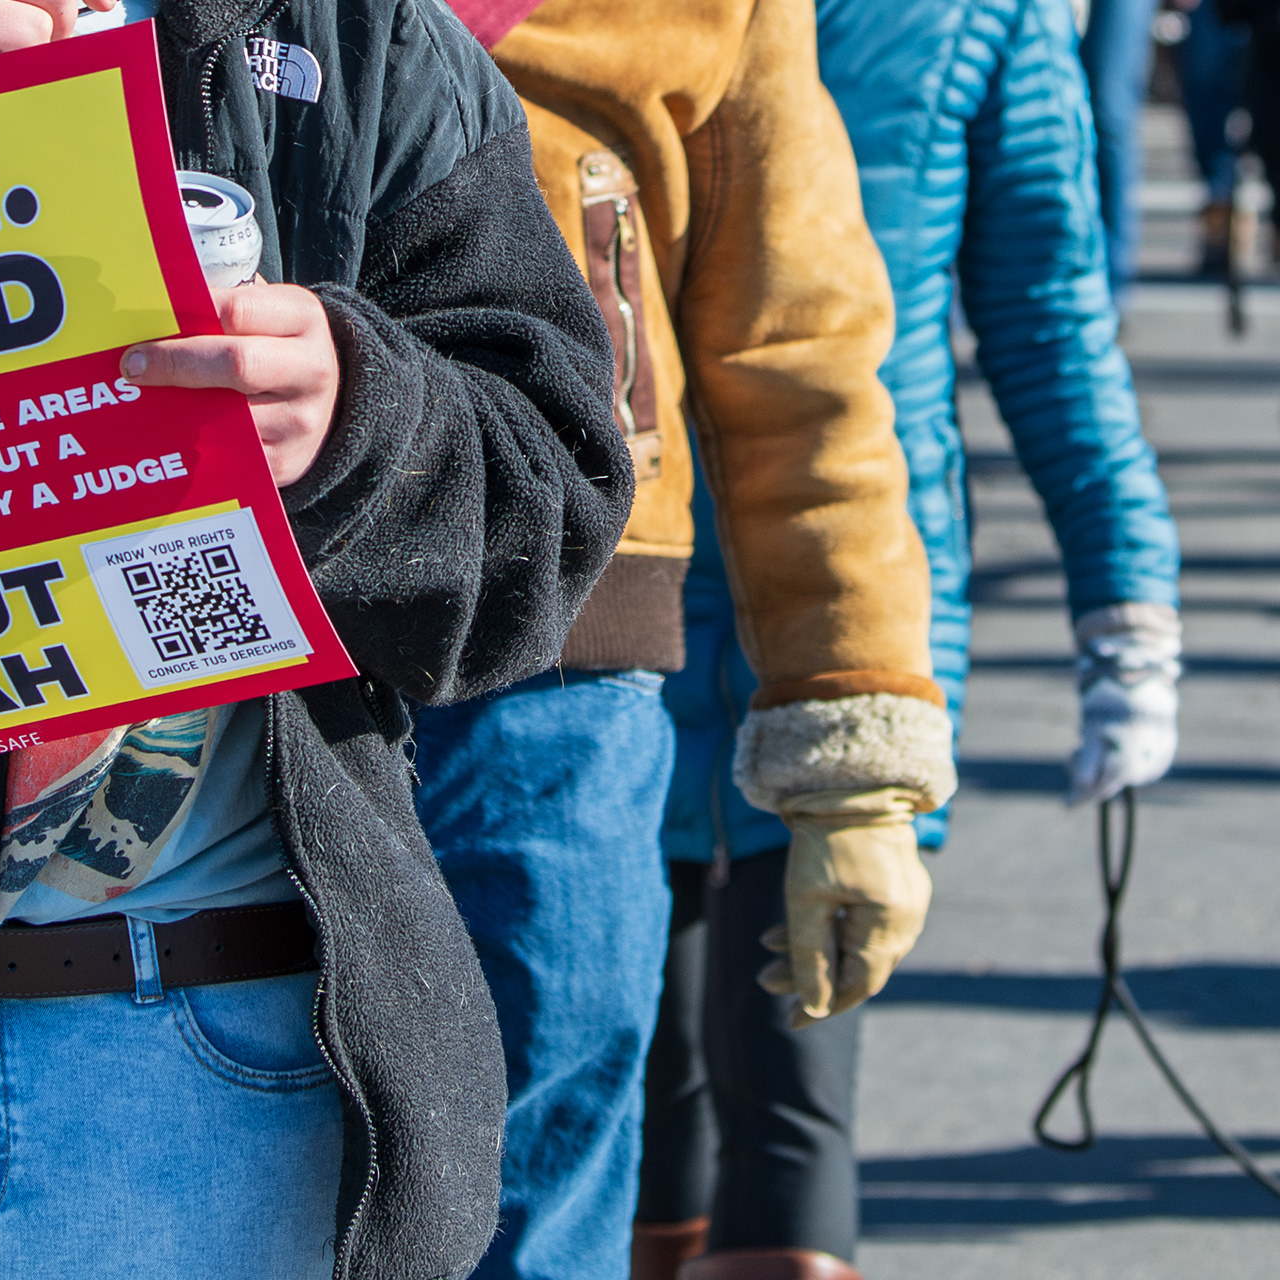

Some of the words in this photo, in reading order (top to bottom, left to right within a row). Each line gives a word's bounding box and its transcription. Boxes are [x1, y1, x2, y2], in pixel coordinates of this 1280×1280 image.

[243, 47, 286, 78] RTH
[248, 37, 289, 59] THE
[250, 72, 281, 93] ACE
[18, 376, 141, 426] AREAS
[58, 433, 86, 460] A
[32, 482, 60, 509] A
[72, 452, 189, 500] JUDGE
[105, 548, 145, 566] KNOW
[149, 539, 185, 556] YOUR
[188, 528, 236, 548] RIGHTS
[148, 660, 199, 680] CONOCE
[201, 653, 228, 667] TUS
[230, 639, 297, 662] DERECHOS
